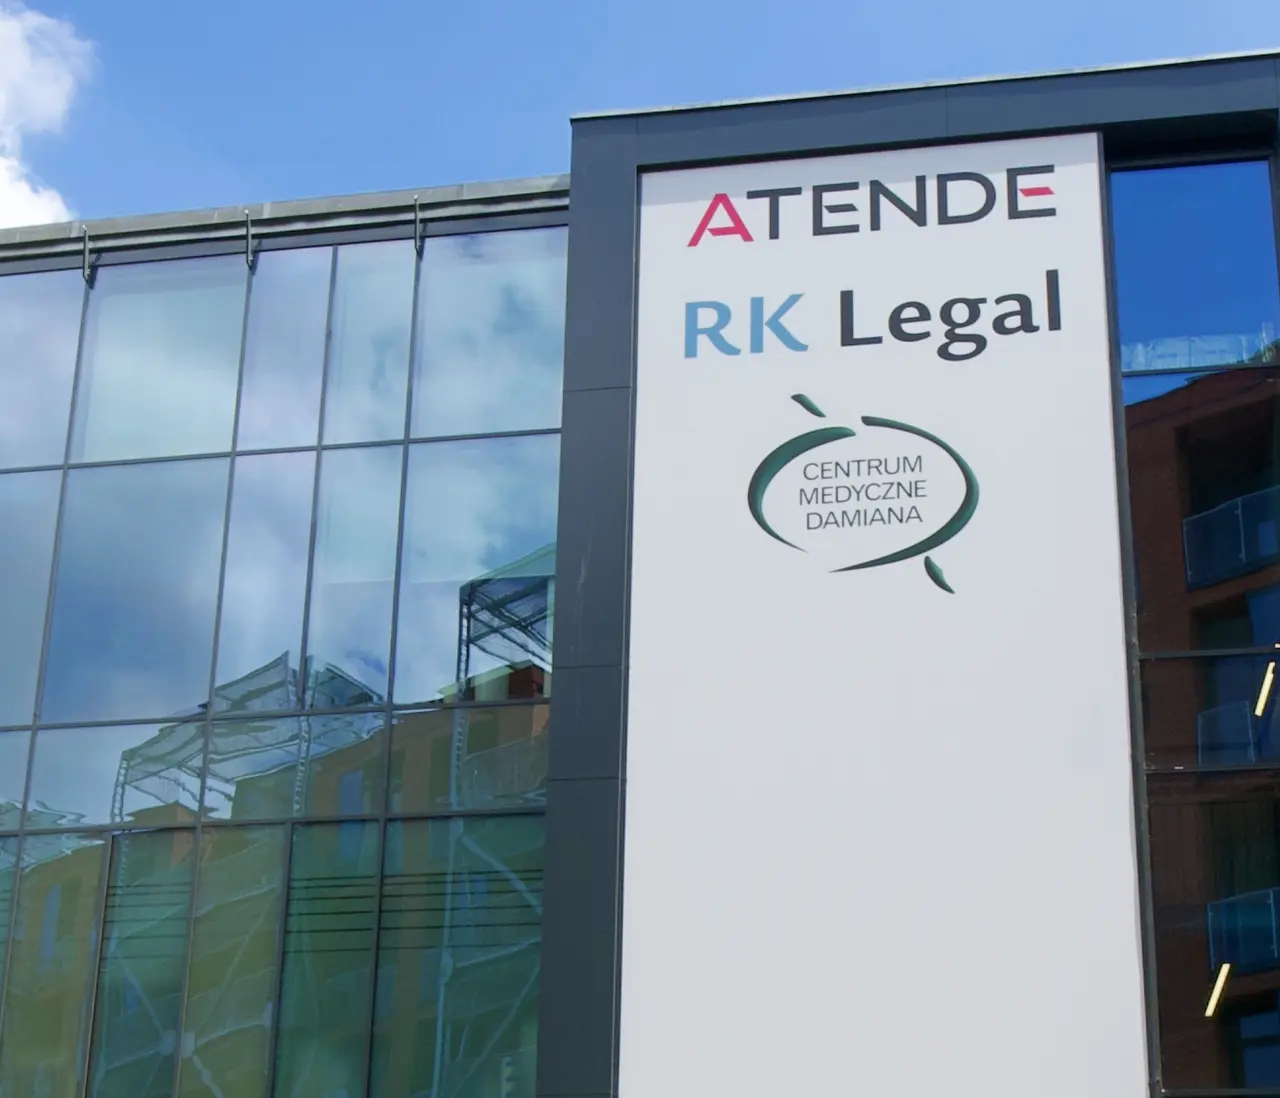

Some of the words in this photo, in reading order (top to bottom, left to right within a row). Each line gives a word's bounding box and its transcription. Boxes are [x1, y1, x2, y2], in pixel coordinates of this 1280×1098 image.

[687, 164, 1056, 247] ATENDE
[684, 293, 809, 358] RK
[839, 269, 1062, 361] Legal
[802, 455, 923, 481] CENTRUM
[799, 480, 928, 506] MEDYCZNE
[806, 505, 924, 530] DAMIANA
